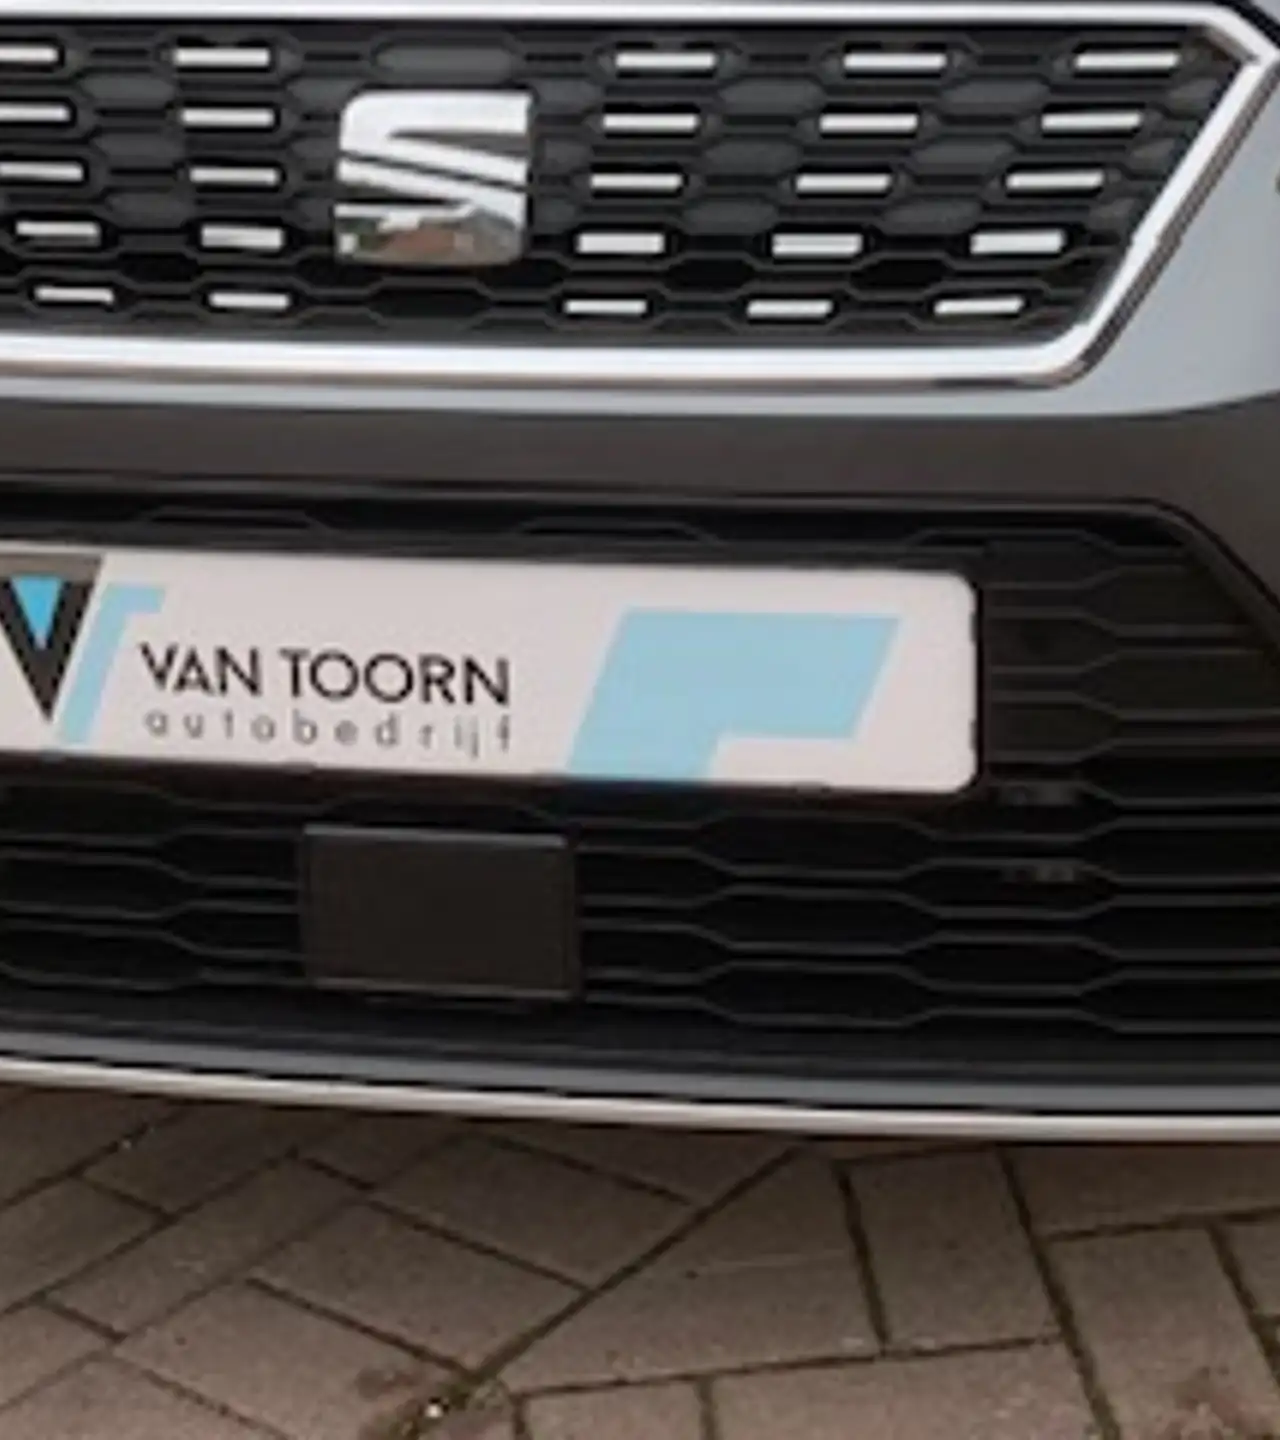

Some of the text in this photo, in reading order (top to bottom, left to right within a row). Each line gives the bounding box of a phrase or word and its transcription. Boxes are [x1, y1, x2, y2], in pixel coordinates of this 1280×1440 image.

[140, 641, 511, 707] VAN TOORN
[145, 708, 513, 759] autobedrijf
